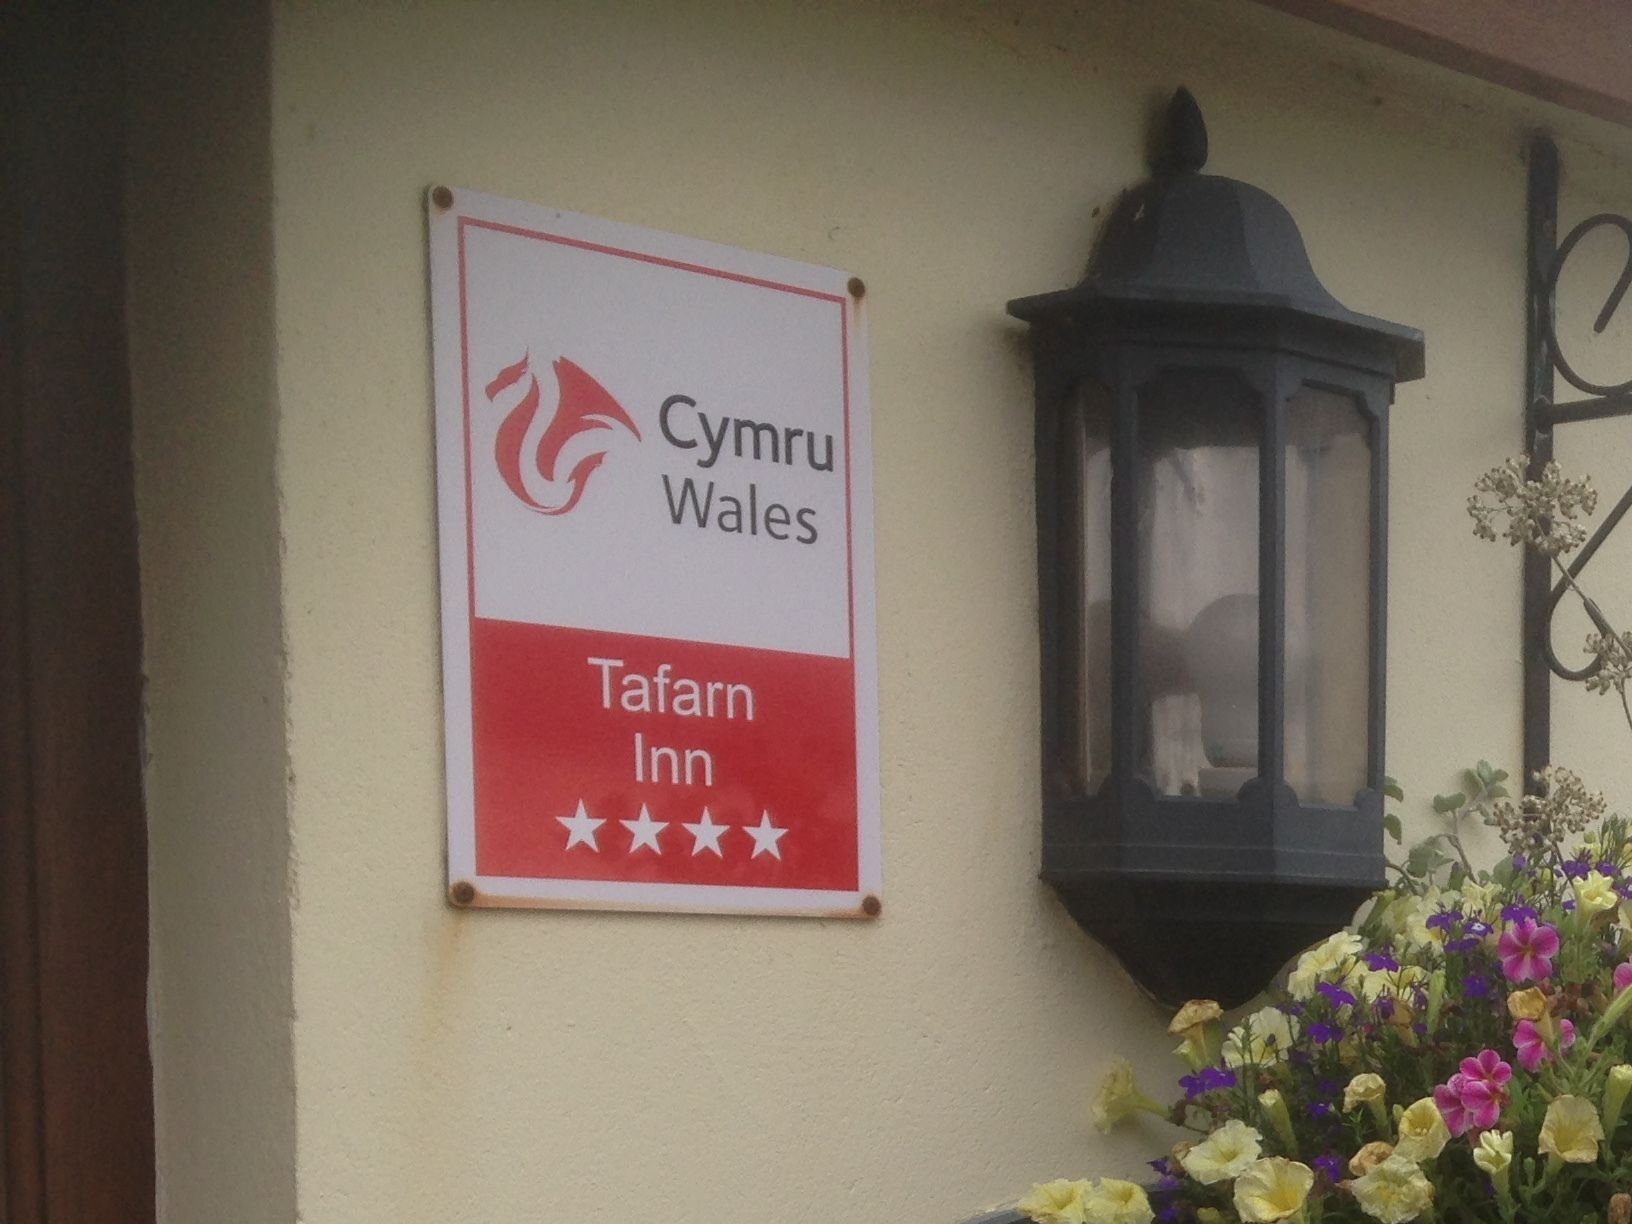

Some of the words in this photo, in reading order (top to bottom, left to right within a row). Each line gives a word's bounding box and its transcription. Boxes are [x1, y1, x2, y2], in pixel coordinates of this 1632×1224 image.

[657, 393, 836, 473] Cymru
[661, 473, 820, 545] Wales
[587, 656, 756, 721] Tafarn
[632, 731, 714, 788] Inn
